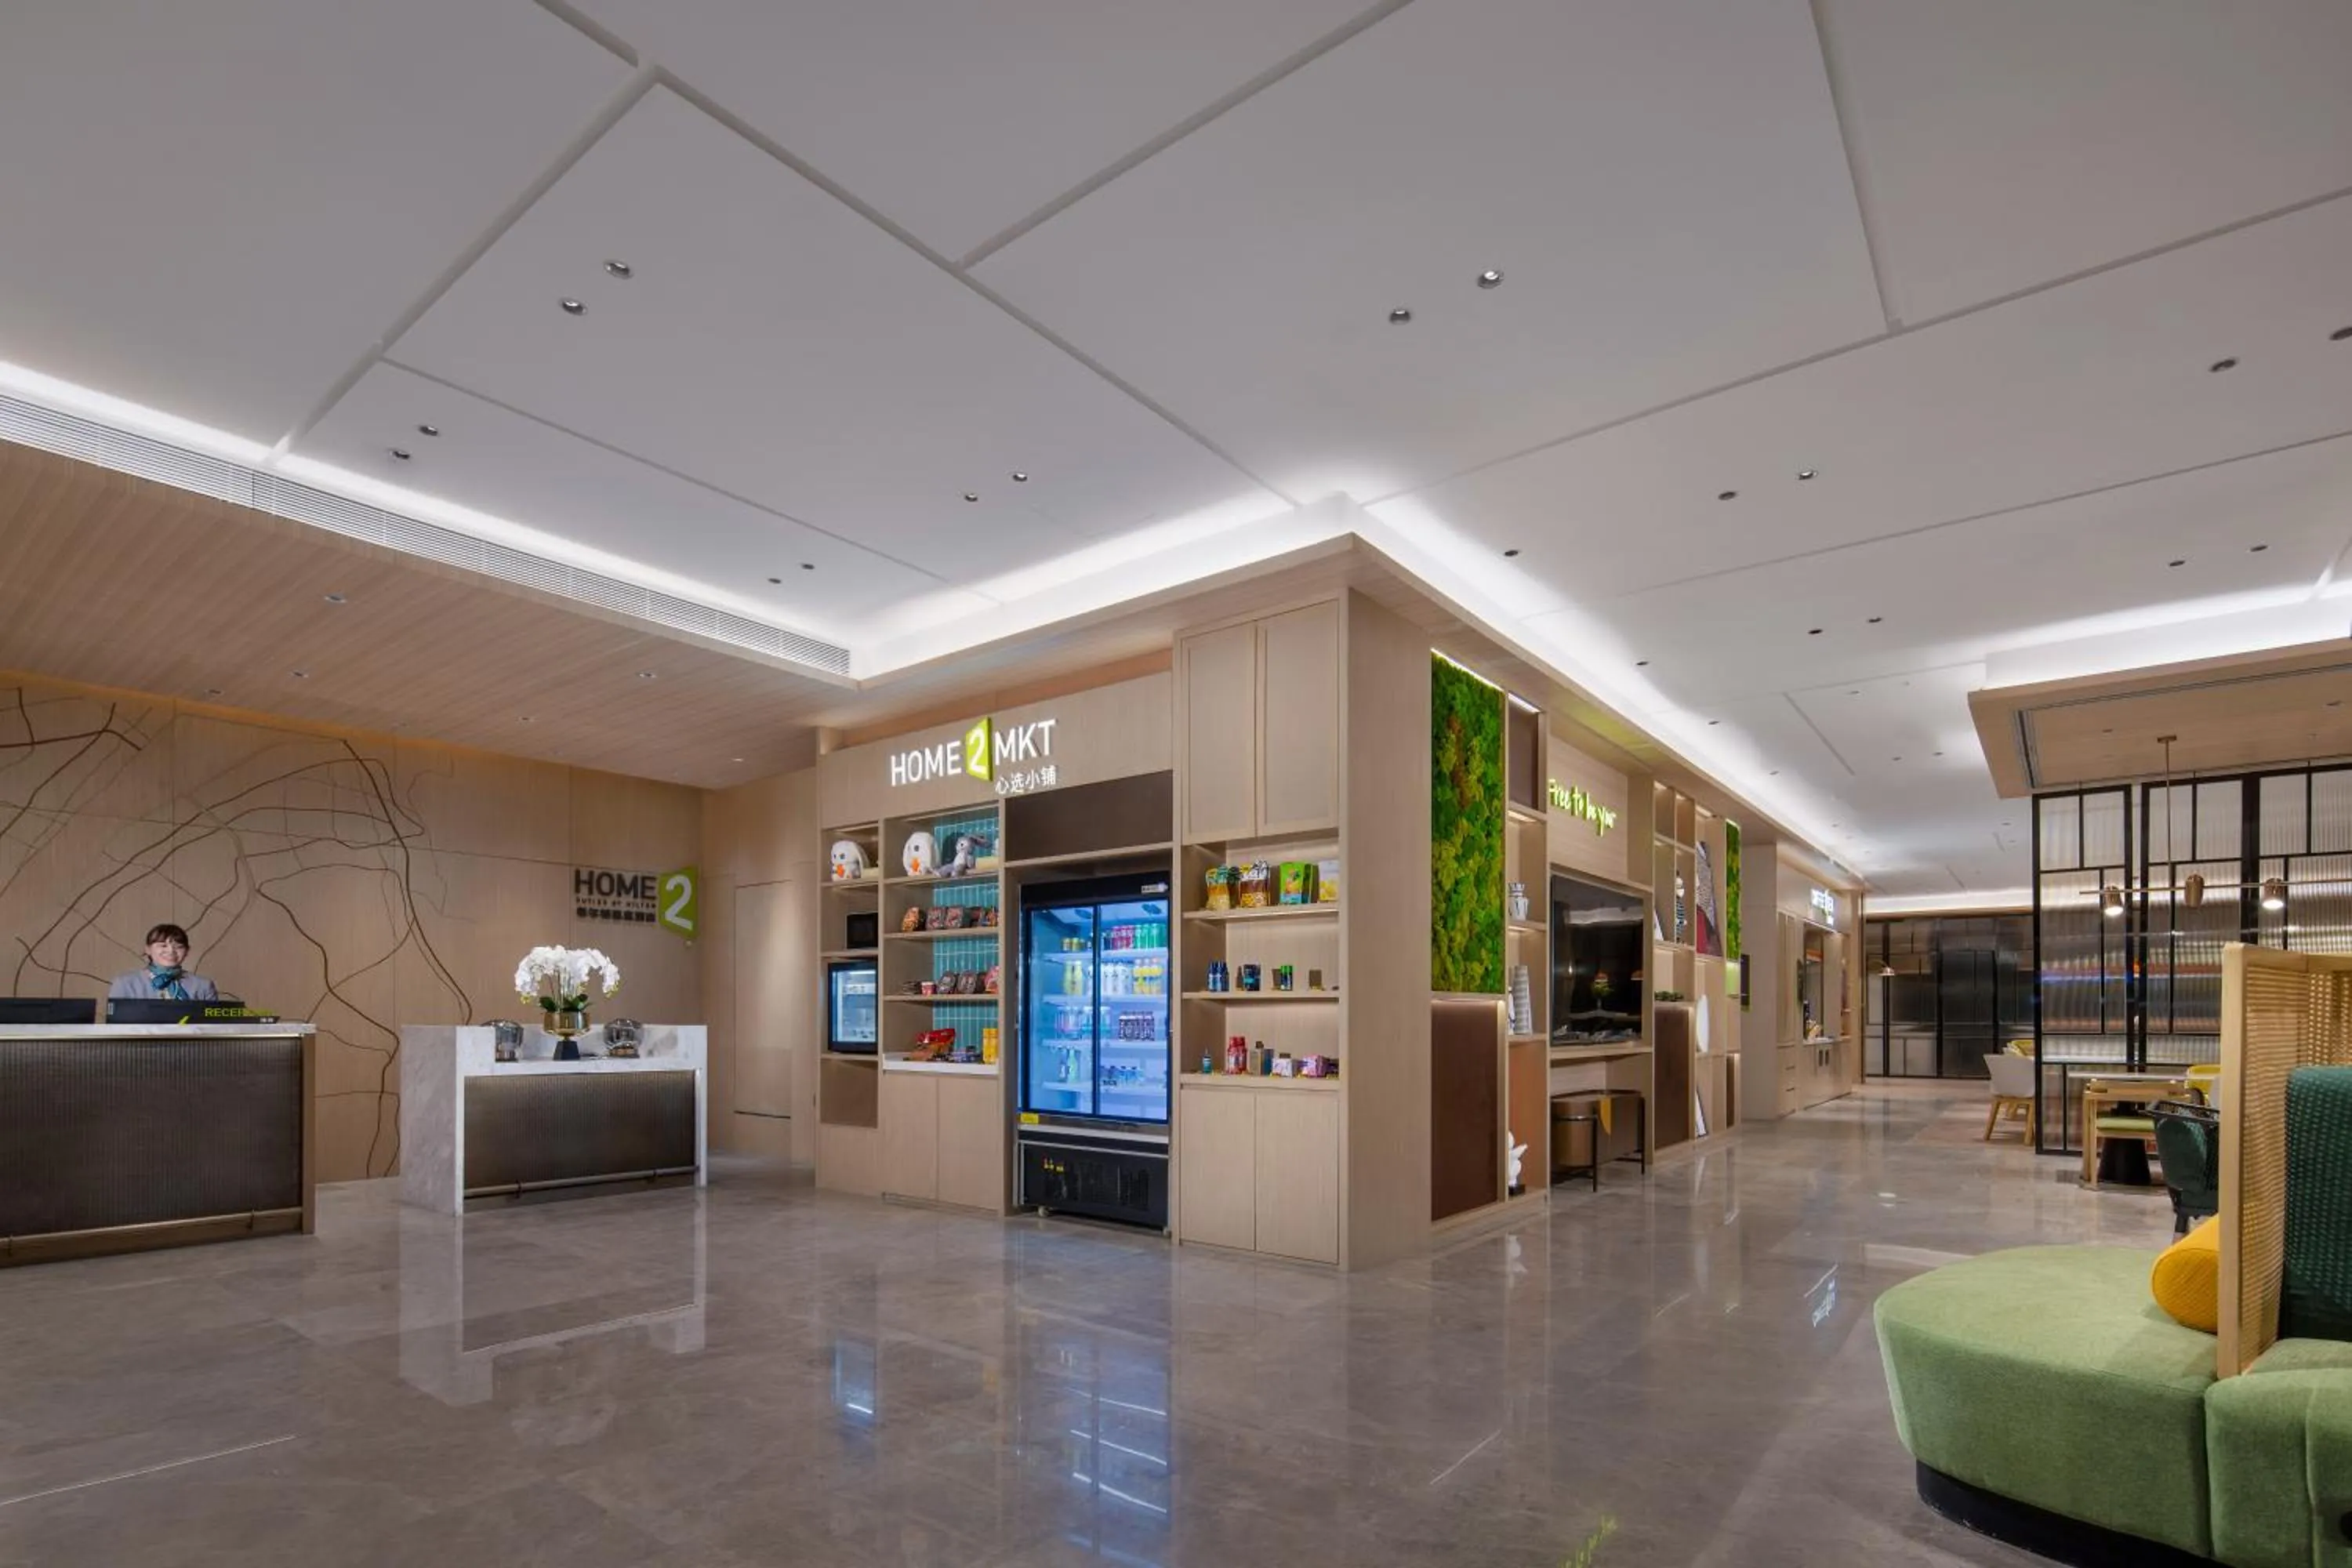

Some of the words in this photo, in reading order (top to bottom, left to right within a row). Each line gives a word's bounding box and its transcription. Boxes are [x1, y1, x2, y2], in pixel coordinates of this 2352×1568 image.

[891, 741, 962, 786] HOME
[968, 728, 988, 775] 2
[994, 719, 1056, 765] MKT
[995, 765, 1057, 794] 心选小铺
[575, 869, 656, 900] HOME
[665, 874, 693, 931] 2
